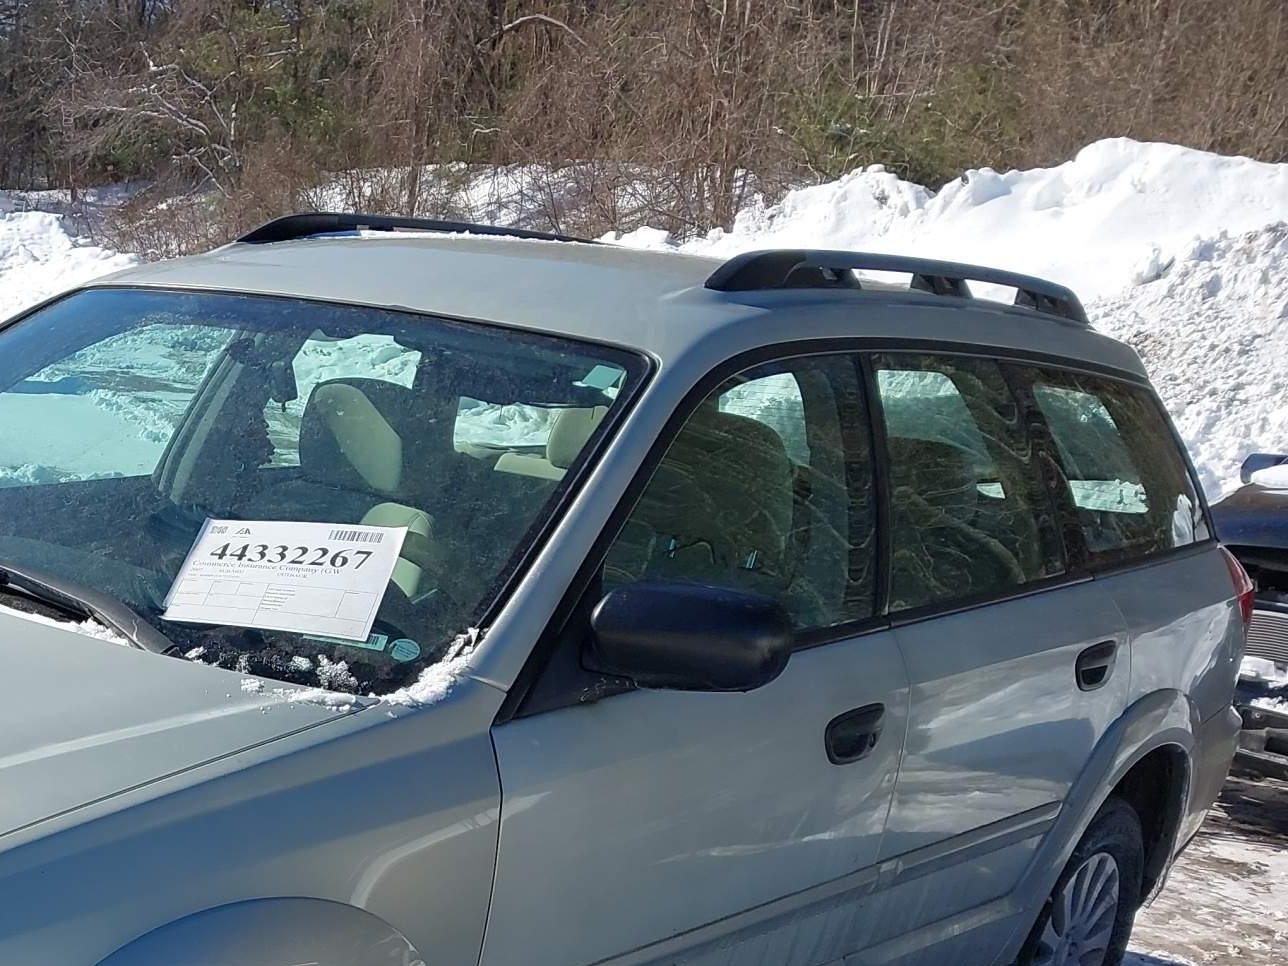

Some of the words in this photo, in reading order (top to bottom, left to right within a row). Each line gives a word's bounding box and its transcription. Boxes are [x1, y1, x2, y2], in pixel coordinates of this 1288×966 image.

[192, 559, 237, 568] Commerce
[238, 562, 277, 570] Insurance
[279, 565, 317, 574] Company
[210, 542, 374, 570] 44332267
